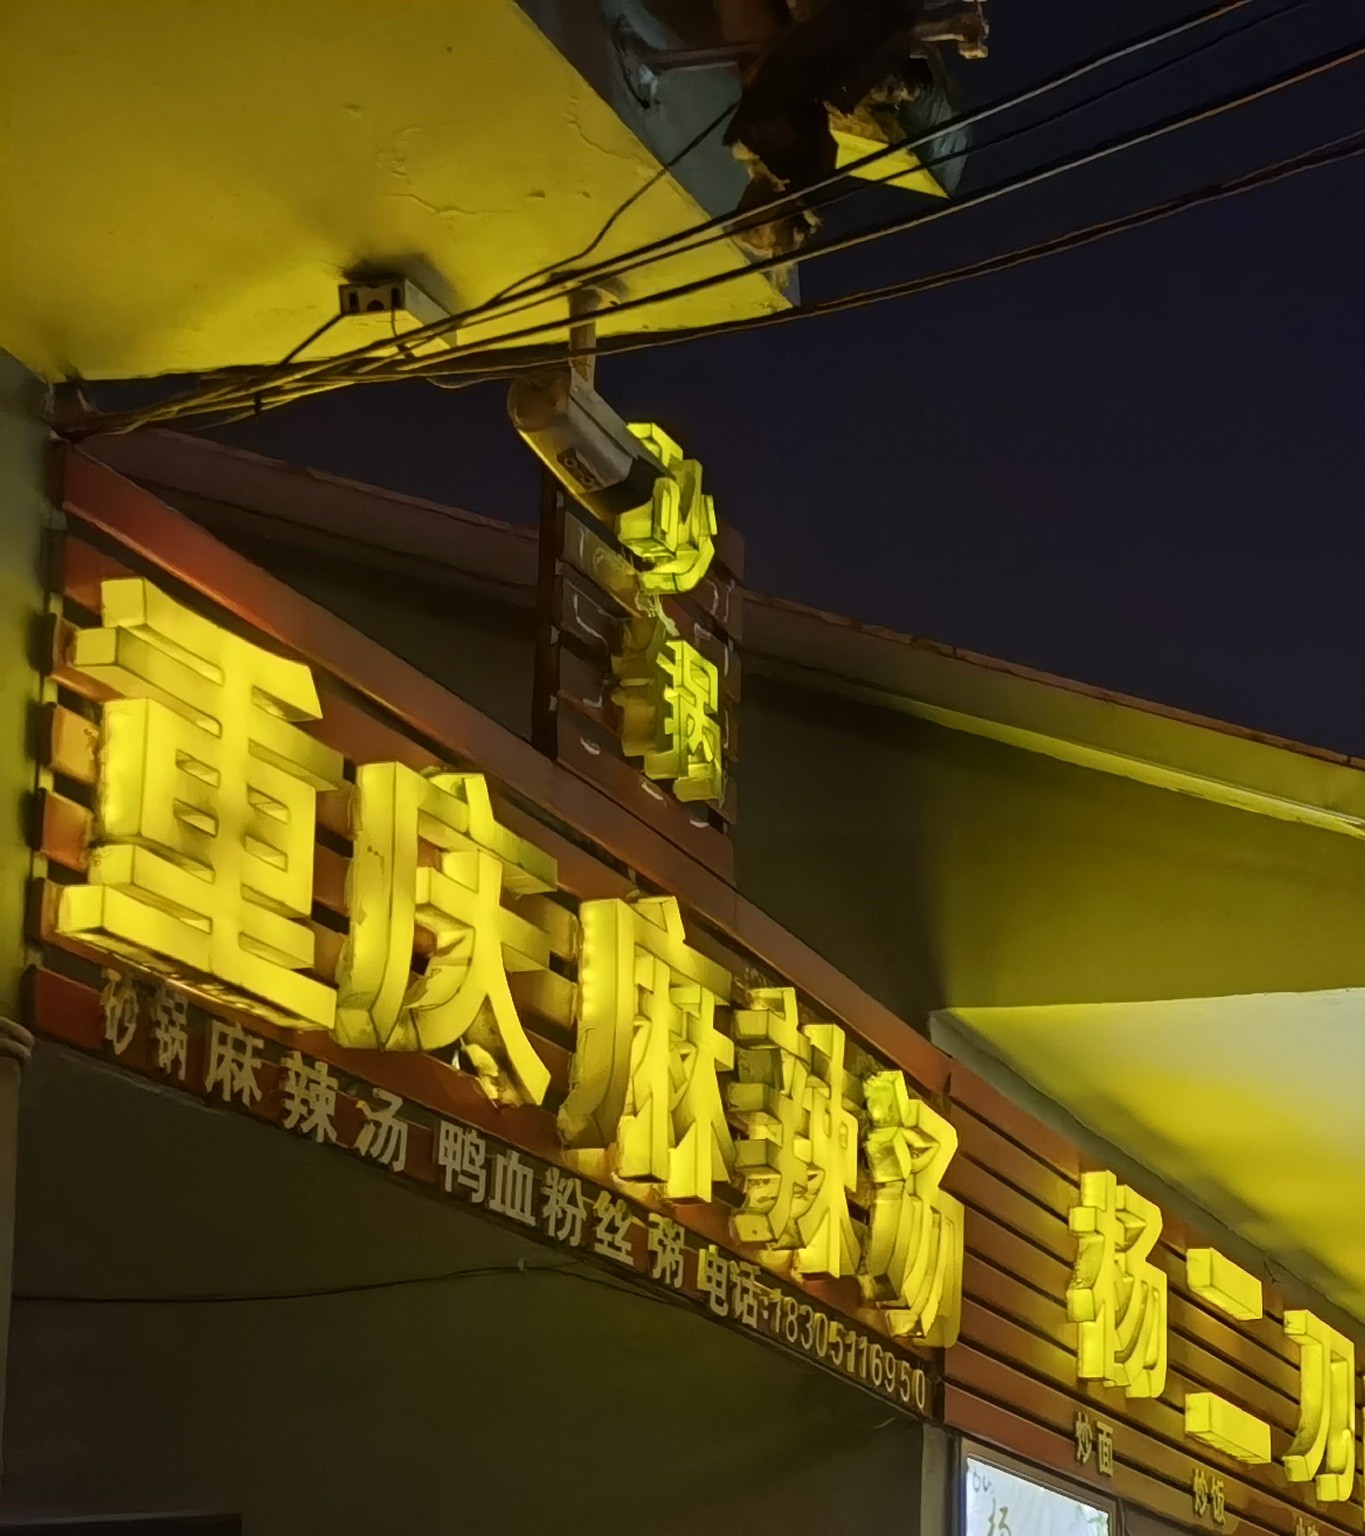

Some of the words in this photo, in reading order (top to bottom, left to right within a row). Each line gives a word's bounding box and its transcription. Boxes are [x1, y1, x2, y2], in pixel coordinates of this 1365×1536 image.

[56, 576, 964, 1348] 重庆麻辣烫
[1073, 1411, 1116, 1479] 炒面
[1192, 1468, 1226, 1526] 炒饭
